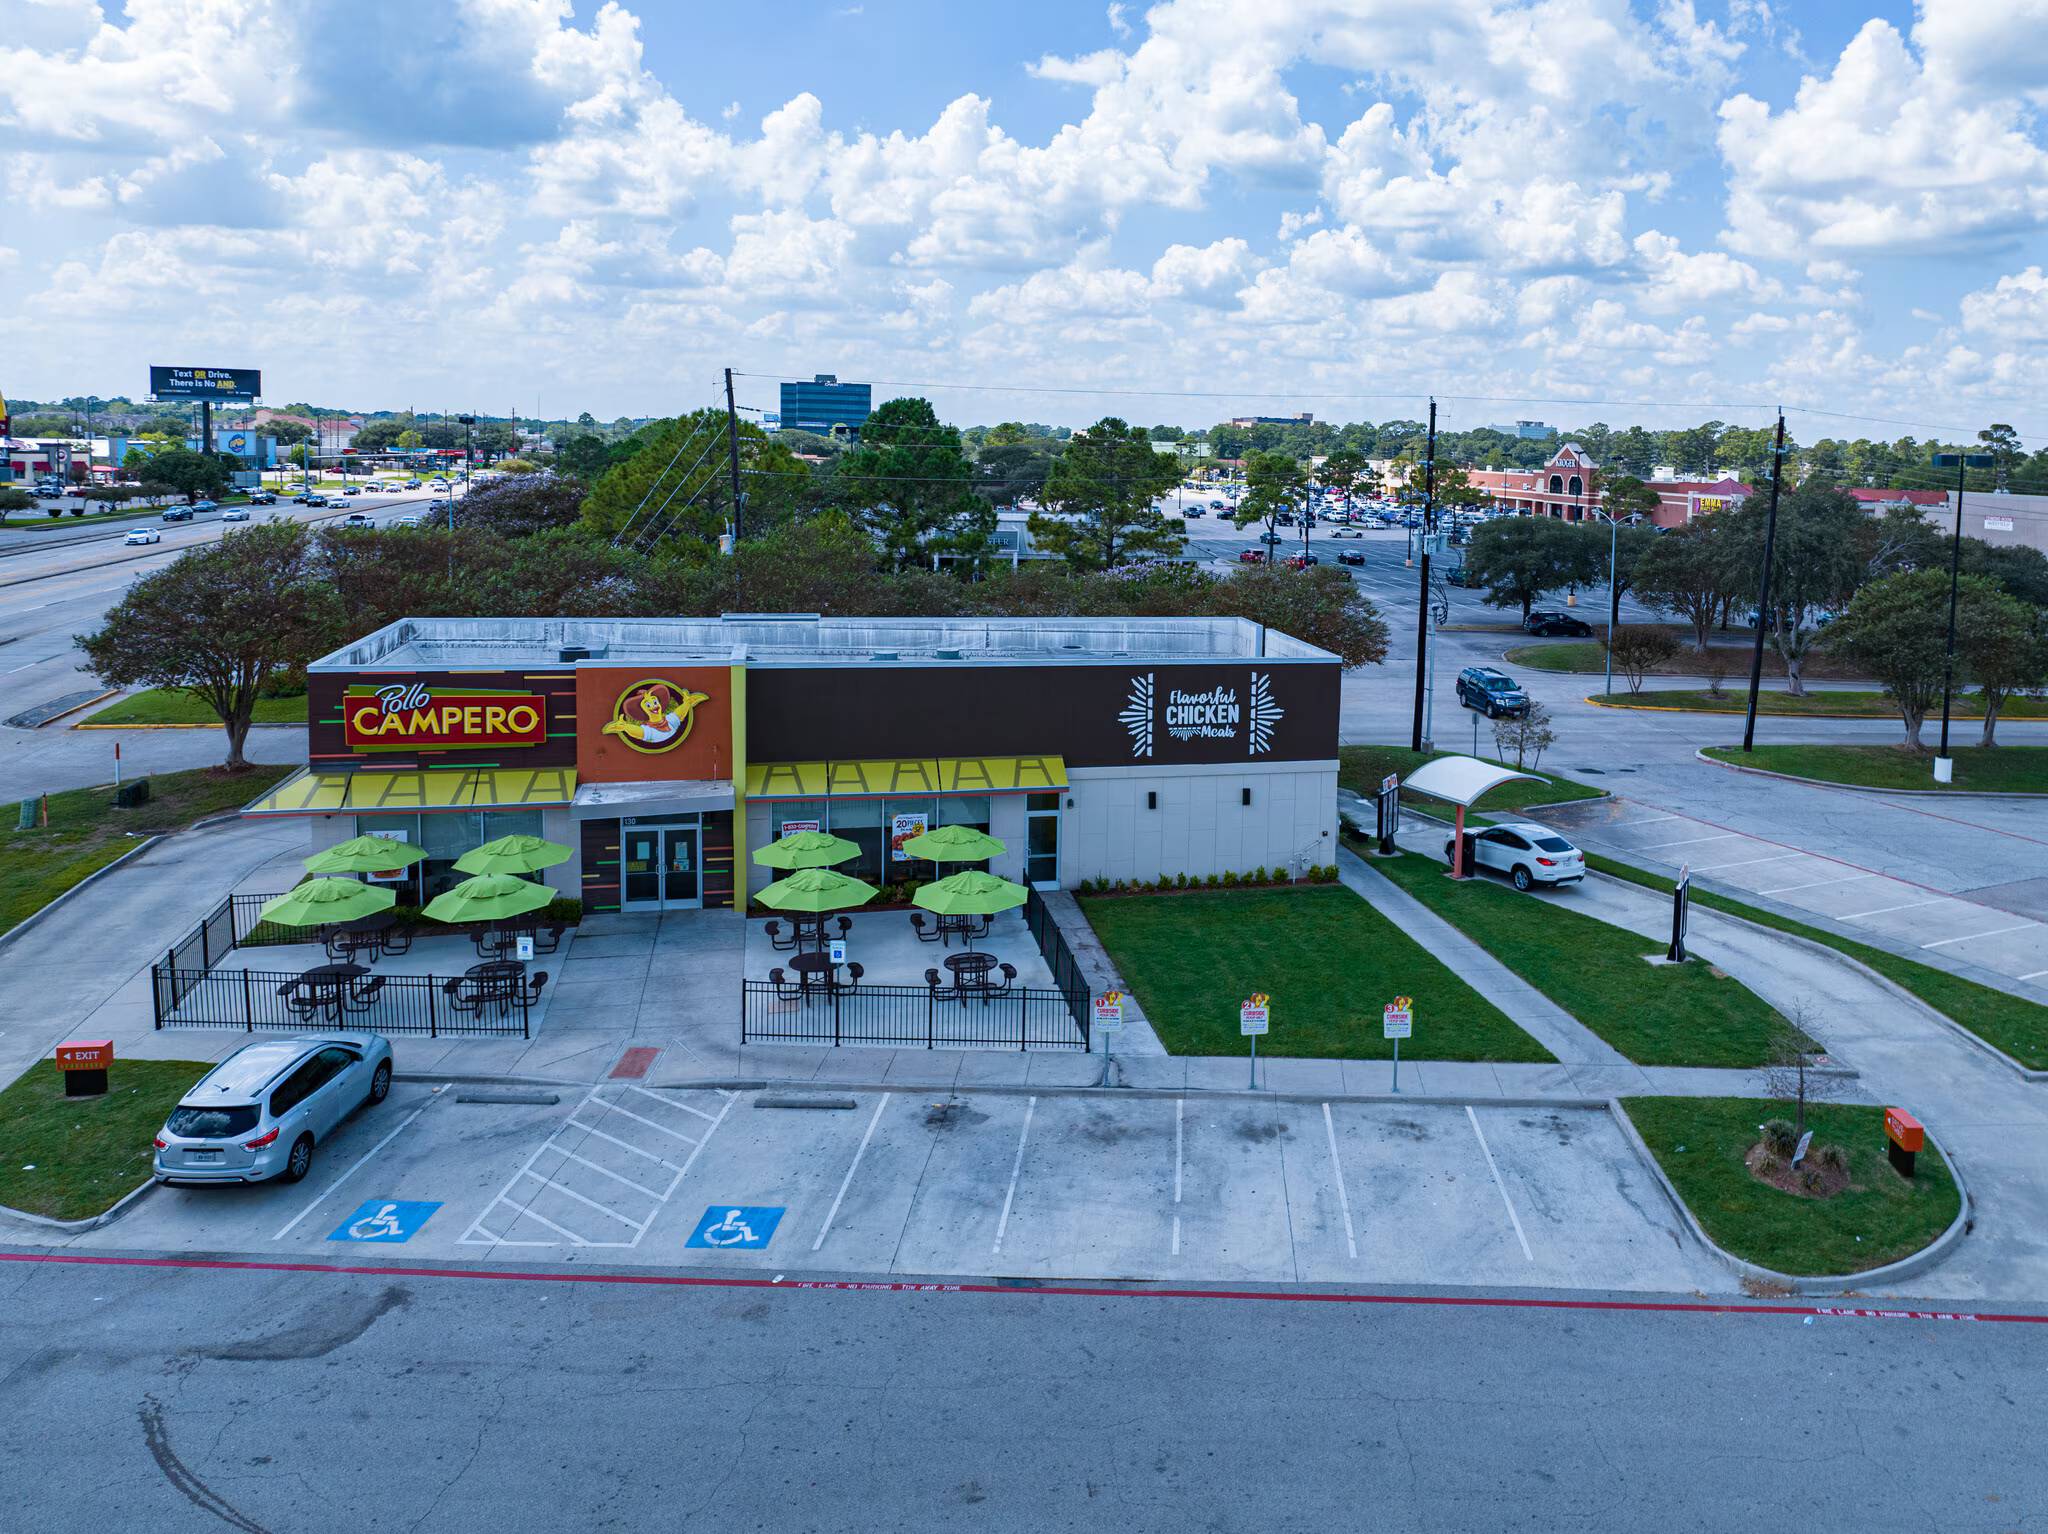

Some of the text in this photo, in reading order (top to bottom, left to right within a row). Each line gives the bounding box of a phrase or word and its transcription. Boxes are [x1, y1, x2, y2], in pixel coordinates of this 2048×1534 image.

[173, 369, 232, 379] Text OR Drive.
[169, 379, 193, 387] There
[204, 380, 216, 388] No
[216, 380, 237, 389] AND.
[1555, 459, 1576, 468] KROGER
[1700, 497, 1722, 507] EMMA
[375, 683, 430, 714] Pollo
[1170, 686, 1236, 705] Flavorful
[1166, 705, 1240, 725] CHICKEN
[352, 705, 540, 736] CAMPERO
[1201, 724, 1236, 738] Meals
[896, 820, 907, 828] 20
[1244, 1001, 1251, 1009] 2
[1387, 1004, 1394, 1012] 3
[75, 1051, 100, 1060] EXIT
